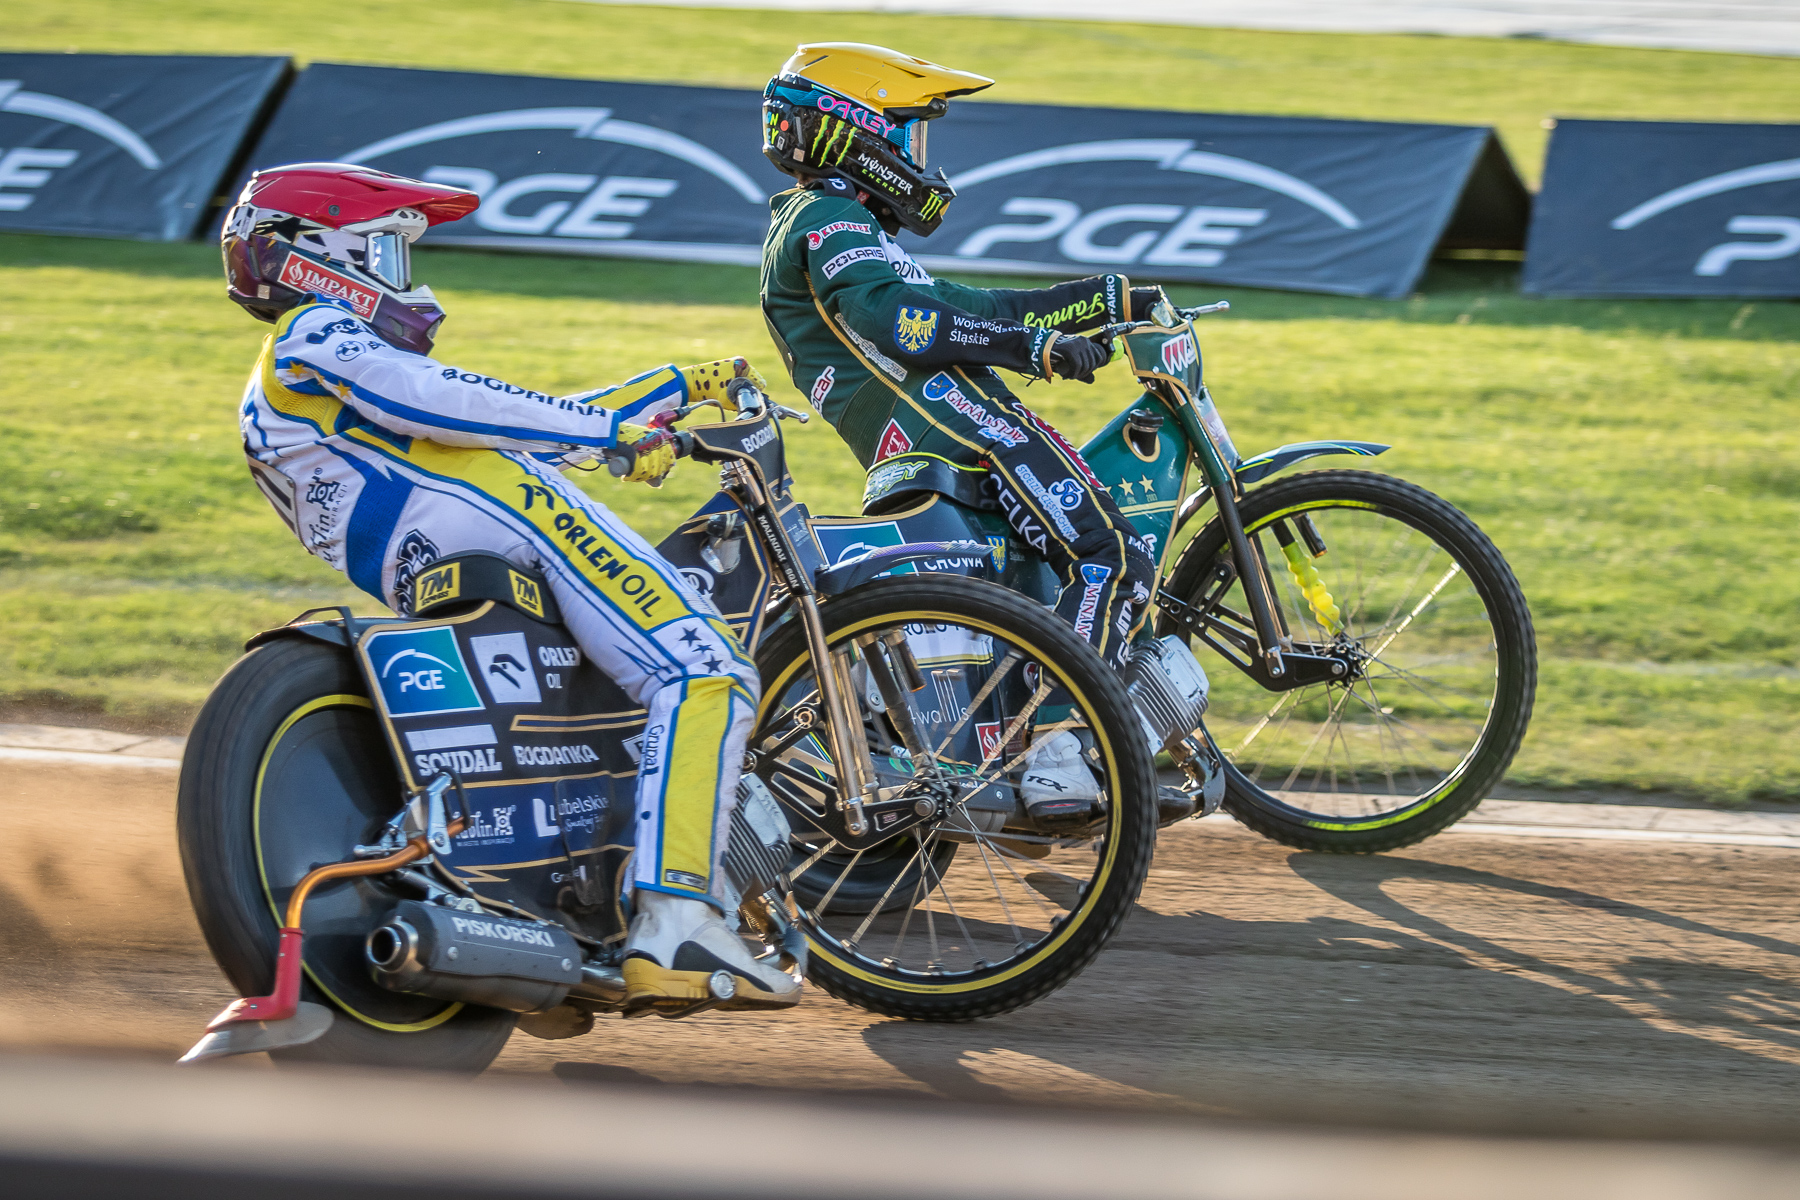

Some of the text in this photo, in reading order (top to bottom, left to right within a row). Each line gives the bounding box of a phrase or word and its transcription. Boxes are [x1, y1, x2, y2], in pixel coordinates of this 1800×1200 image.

[817, 95, 897, 138] OAKLEY
[861, 168, 901, 196] ENERGY
[955, 197, 1269, 267] PGE
[824, 248, 885, 276] POLARIS
[304, 268, 375, 308] IMPAKT
[1105, 274, 1117, 315] FAKRO
[949, 328, 990, 346] Śląskie
[946, 390, 984, 422] GMNA
[554, 513, 663, 618] ORLEN OIL
[420, 567, 454, 601] TM
[514, 575, 539, 605] TM
[398, 669, 446, 693] PGE
[546, 673, 563, 689] OIL
[415, 748, 503, 777] SOUDAL
[512, 744, 600, 767] BOGDANKA
[1026, 774, 1068, 792] TCX
[451, 916, 556, 948] PISKORSKI
